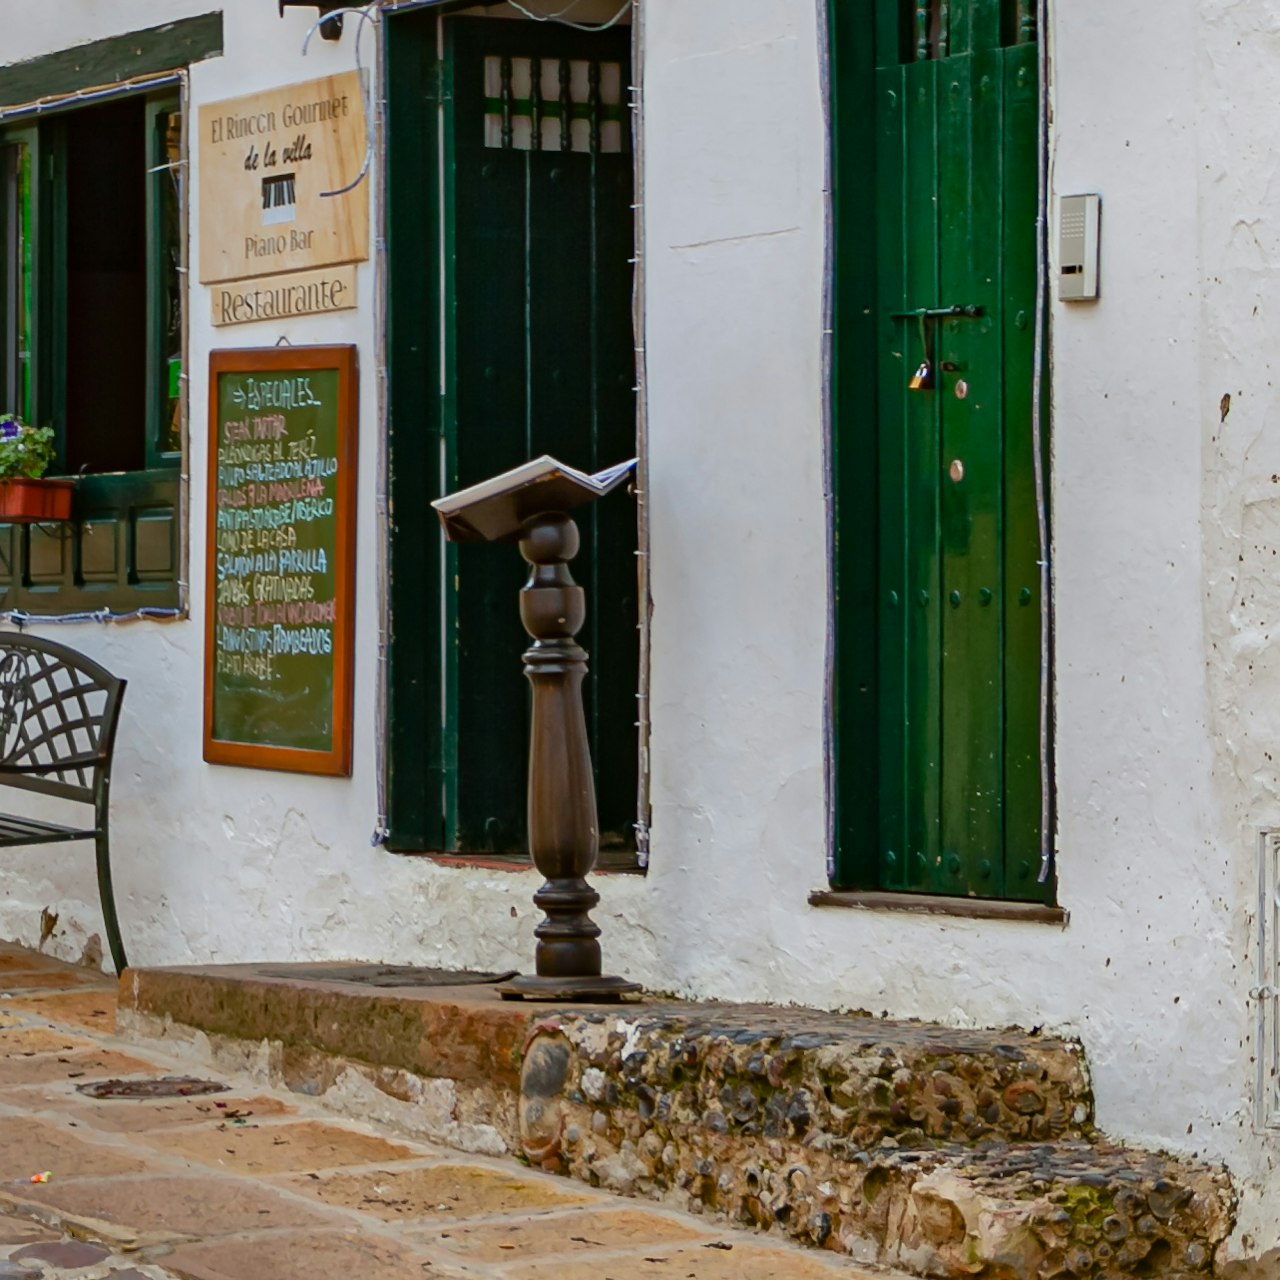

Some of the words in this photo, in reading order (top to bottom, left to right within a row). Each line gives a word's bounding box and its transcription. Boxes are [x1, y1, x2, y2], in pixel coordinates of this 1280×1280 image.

[212, 117, 223, 144] El
[283, 91, 349, 128] Gourmet
[244, 144, 259, 171] de
[264, 141, 276, 168] la
[283, 134, 313, 165] villa
[245, 233, 287, 259] Piano
[290, 229, 315, 252] Bar
[221, 275, 344, 323] Restaurante
[246, 377, 317, 411] ESPECIALES
